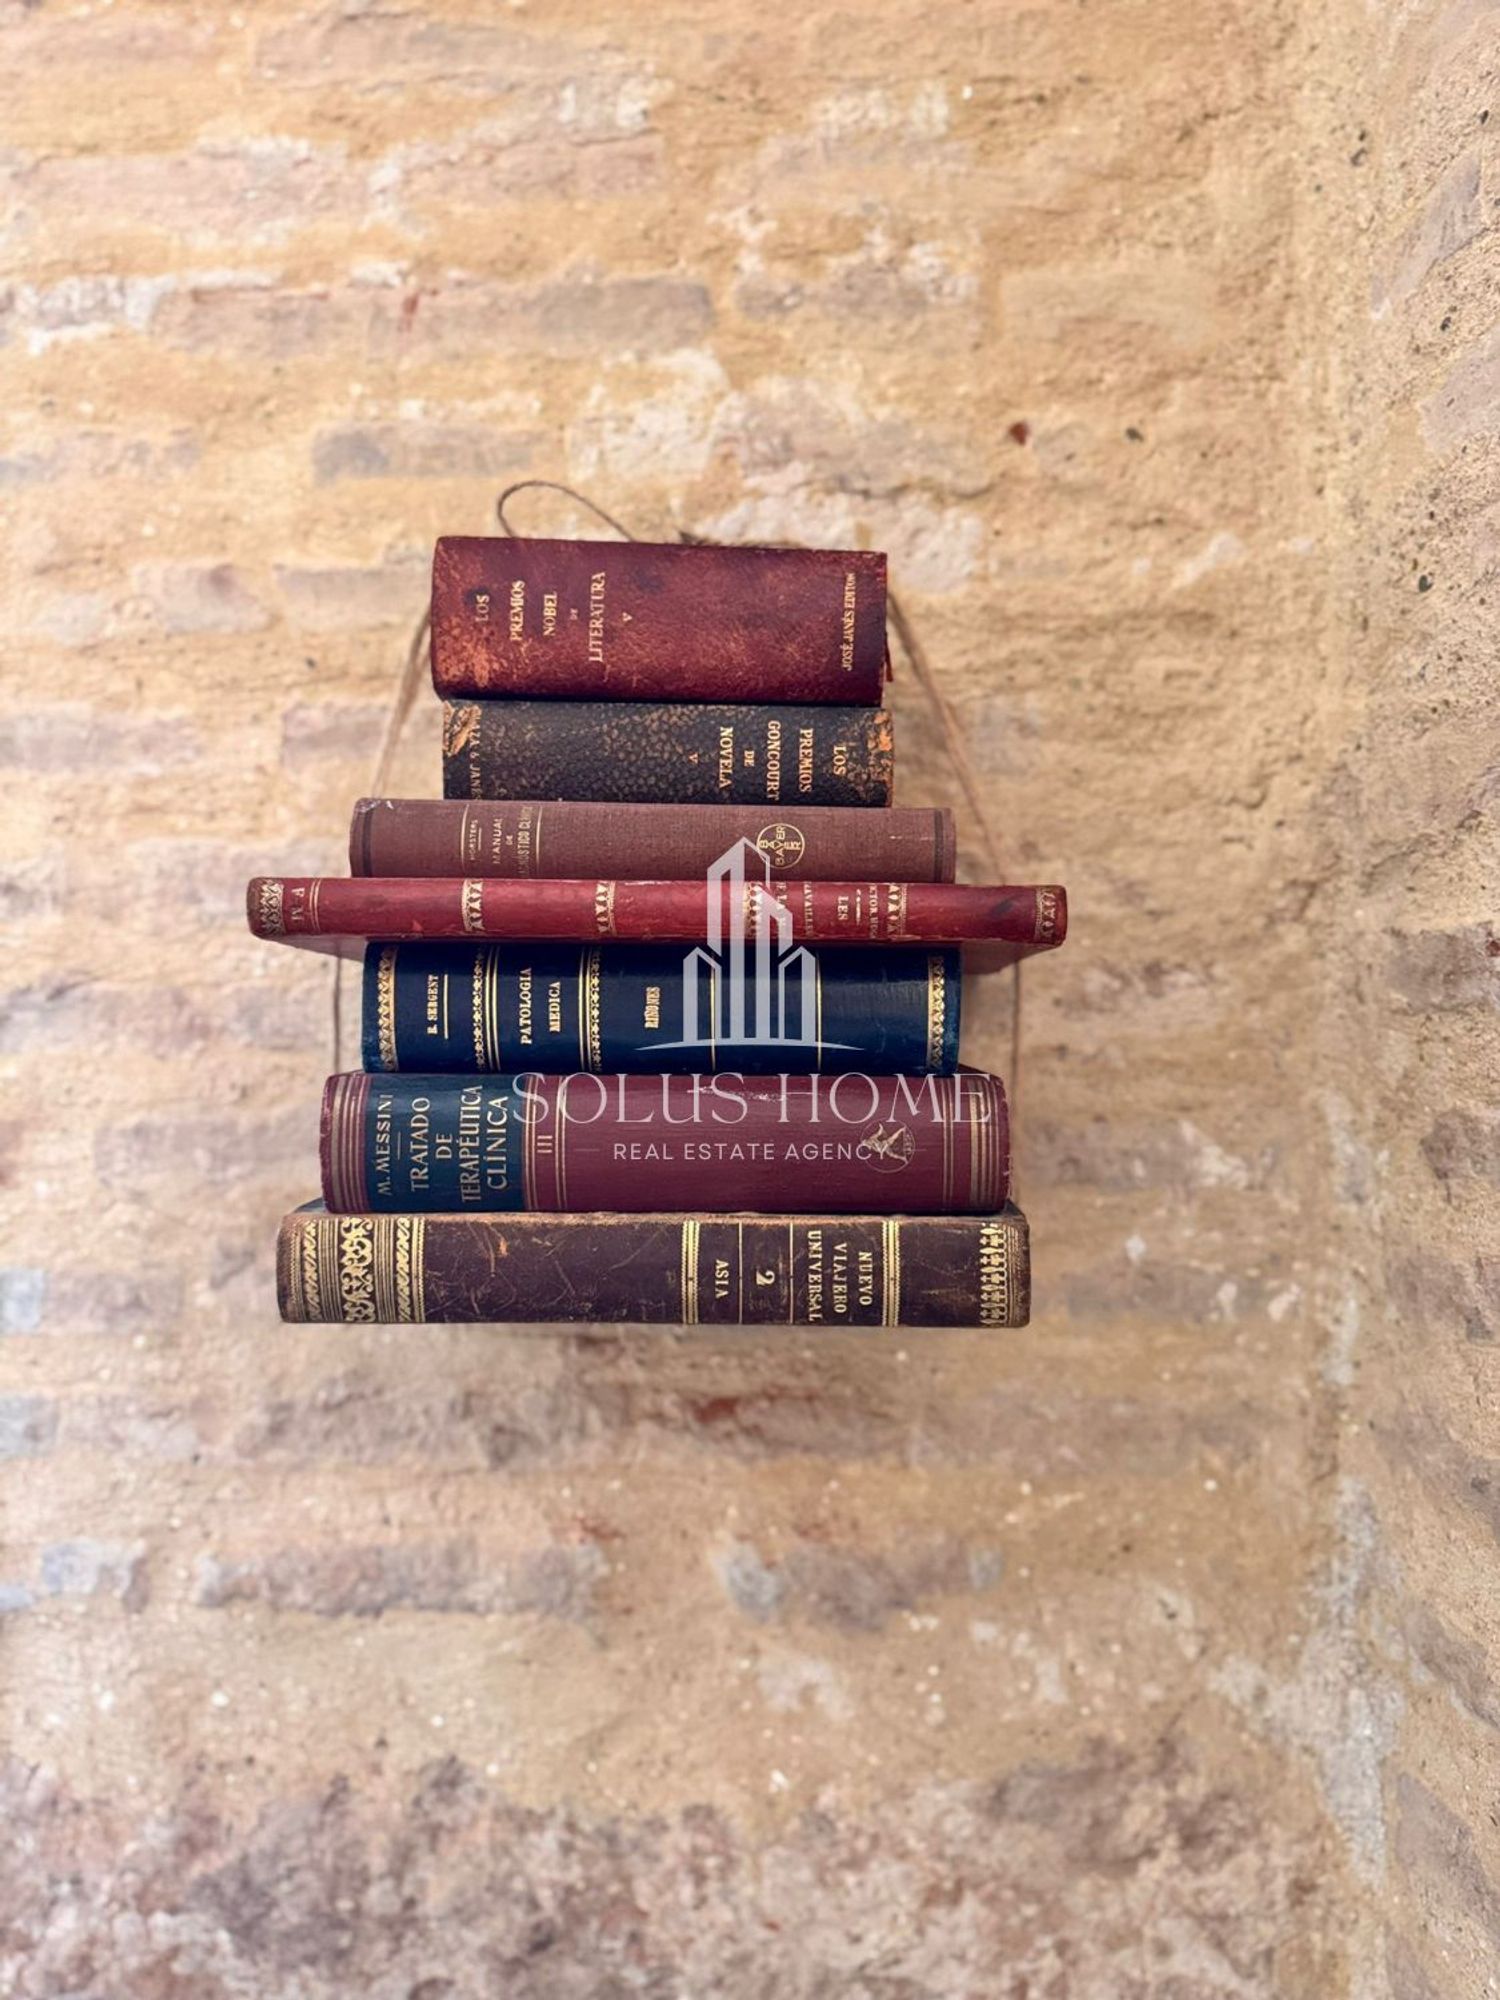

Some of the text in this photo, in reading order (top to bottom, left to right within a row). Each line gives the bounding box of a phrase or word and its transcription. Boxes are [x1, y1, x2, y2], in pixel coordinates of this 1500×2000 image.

[475, 594, 490, 622] LOS
[510, 580, 526, 641] PREMIOS
[543, 592, 557, 636] NOBEL
[570, 608, 579, 620] DE
[589, 572, 606, 662] LITERATURA
[841, 610, 855, 642] JANÉS
[839, 643, 854, 672] JOSÉ
[719, 726, 734, 789] NOVELA
[744, 750, 755, 767] DE
[767, 720, 781, 800] GONCOURT
[799, 728, 814, 793] PREMIOS
[833, 745, 847, 776] LOS
[492, 818, 503, 864] MANUAL
[837, 895, 849, 920] LES
[426, 974, 439, 1022] SERGENT
[520, 967, 532, 1045] PATOLOGIA
[548, 981, 561, 1032] MEDICA
[376, 1094, 394, 1196] M. MESSINI
[410, 1097, 431, 1192] TRATADO
[435, 1133, 454, 1160] DE
[456, 1085, 483, 1203] TERAPÉUTICA
[484, 1096, 509, 1190] CLÍNICA
[537, 1134, 553, 1154] III
[715, 1259, 730, 1299] ASIA
[755, 1270, 776, 1287] 2
[807, 1230, 823, 1322] UNIVERSAL
[832, 1242, 848, 1314] VIAJERO
[858, 1251, 873, 1306] NUEVO
